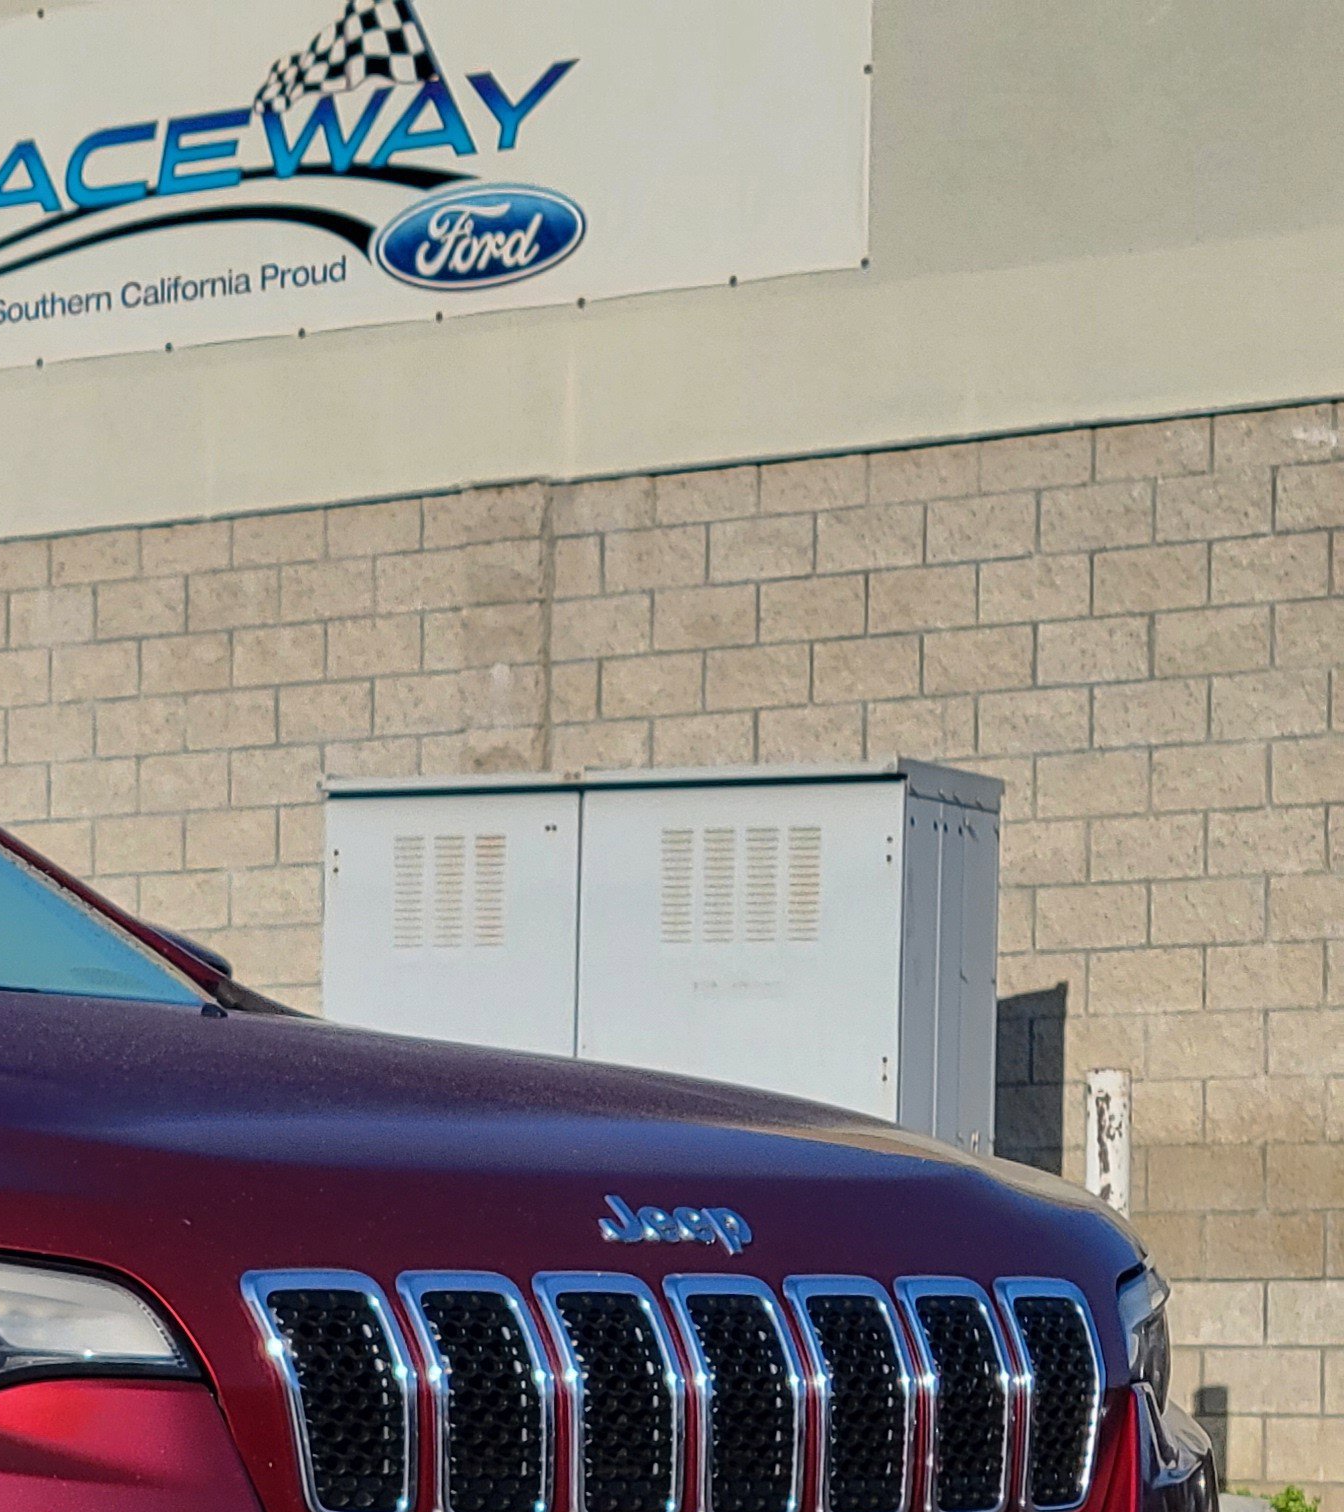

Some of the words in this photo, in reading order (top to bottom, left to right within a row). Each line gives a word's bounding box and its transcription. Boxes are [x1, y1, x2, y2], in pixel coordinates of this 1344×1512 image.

[414, 205, 540, 275] Ford
[120, 270, 252, 312] California
[259, 254, 348, 290] Proud
[598, 1193, 753, 1256] Jeep
